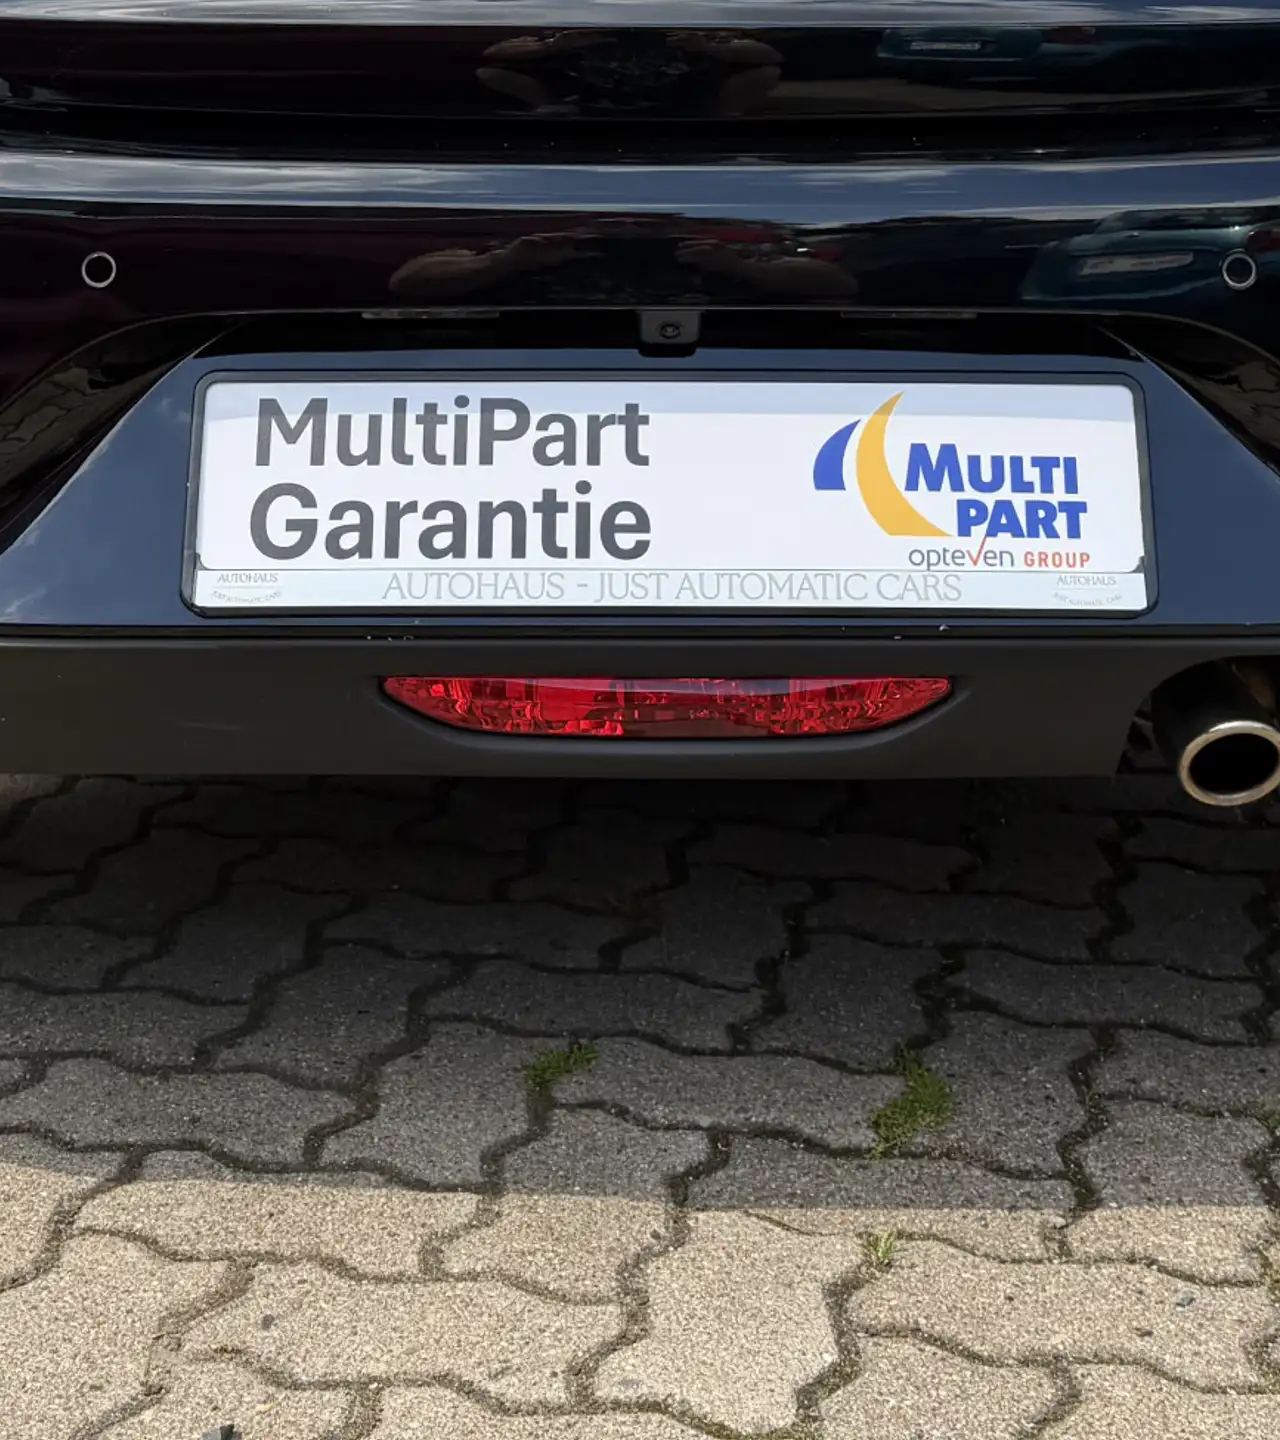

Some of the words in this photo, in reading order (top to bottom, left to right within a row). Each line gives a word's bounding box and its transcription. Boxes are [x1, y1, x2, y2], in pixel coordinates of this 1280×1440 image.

[255, 394, 651, 466] MultiPart
[904, 443, 1079, 495] MULTI
[249, 479, 652, 561] Garantie
[956, 499, 1088, 539] PART
[908, 537, 1015, 571] opteven
[1023, 551, 1091, 569] GROUP
[217, 572, 279, 584] AUTOHAUS
[381, 572, 565, 600] AUTOHAUS
[594, 572, 670, 603] JUST
[674, 572, 868, 601] AUTOMATIC
[876, 573, 962, 601] CARS
[1056, 575, 1117, 586] AUTOHAUS
